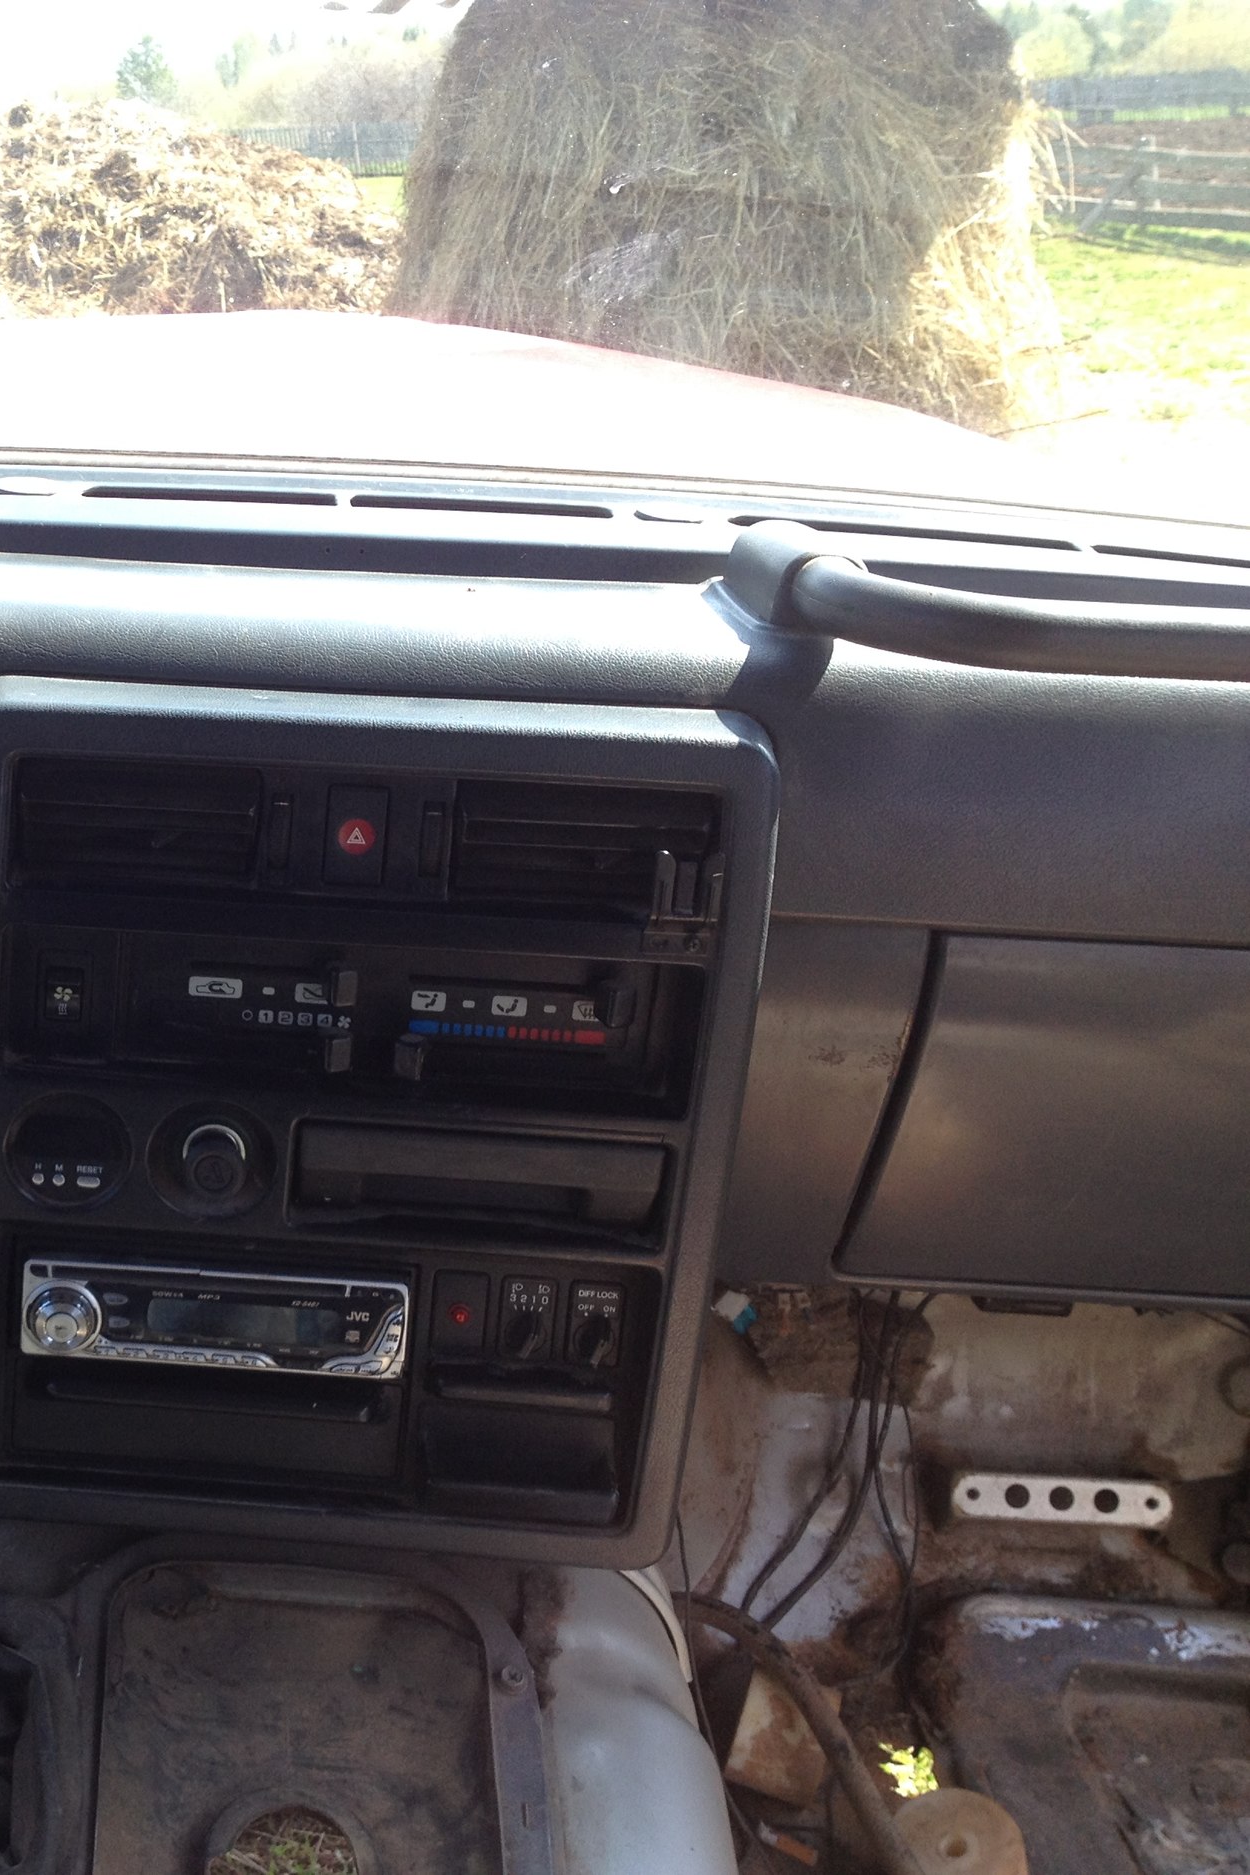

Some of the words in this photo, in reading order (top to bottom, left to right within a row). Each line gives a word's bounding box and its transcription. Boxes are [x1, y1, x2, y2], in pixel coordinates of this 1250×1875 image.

[54, 1164, 64, 1172] M
[76, 1165, 104, 1174] RESET
[197, 1293, 221, 1301] MP3
[509, 1293, 517, 1302] 3
[541, 1296, 549, 1305] 0
[578, 1289, 595, 1298] DIFF
[597, 1291, 619, 1300] LOCK
[577, 1303, 595, 1311] OFF
[602, 1305, 616, 1313] ON
[346, 1311, 370, 1322] JVC
